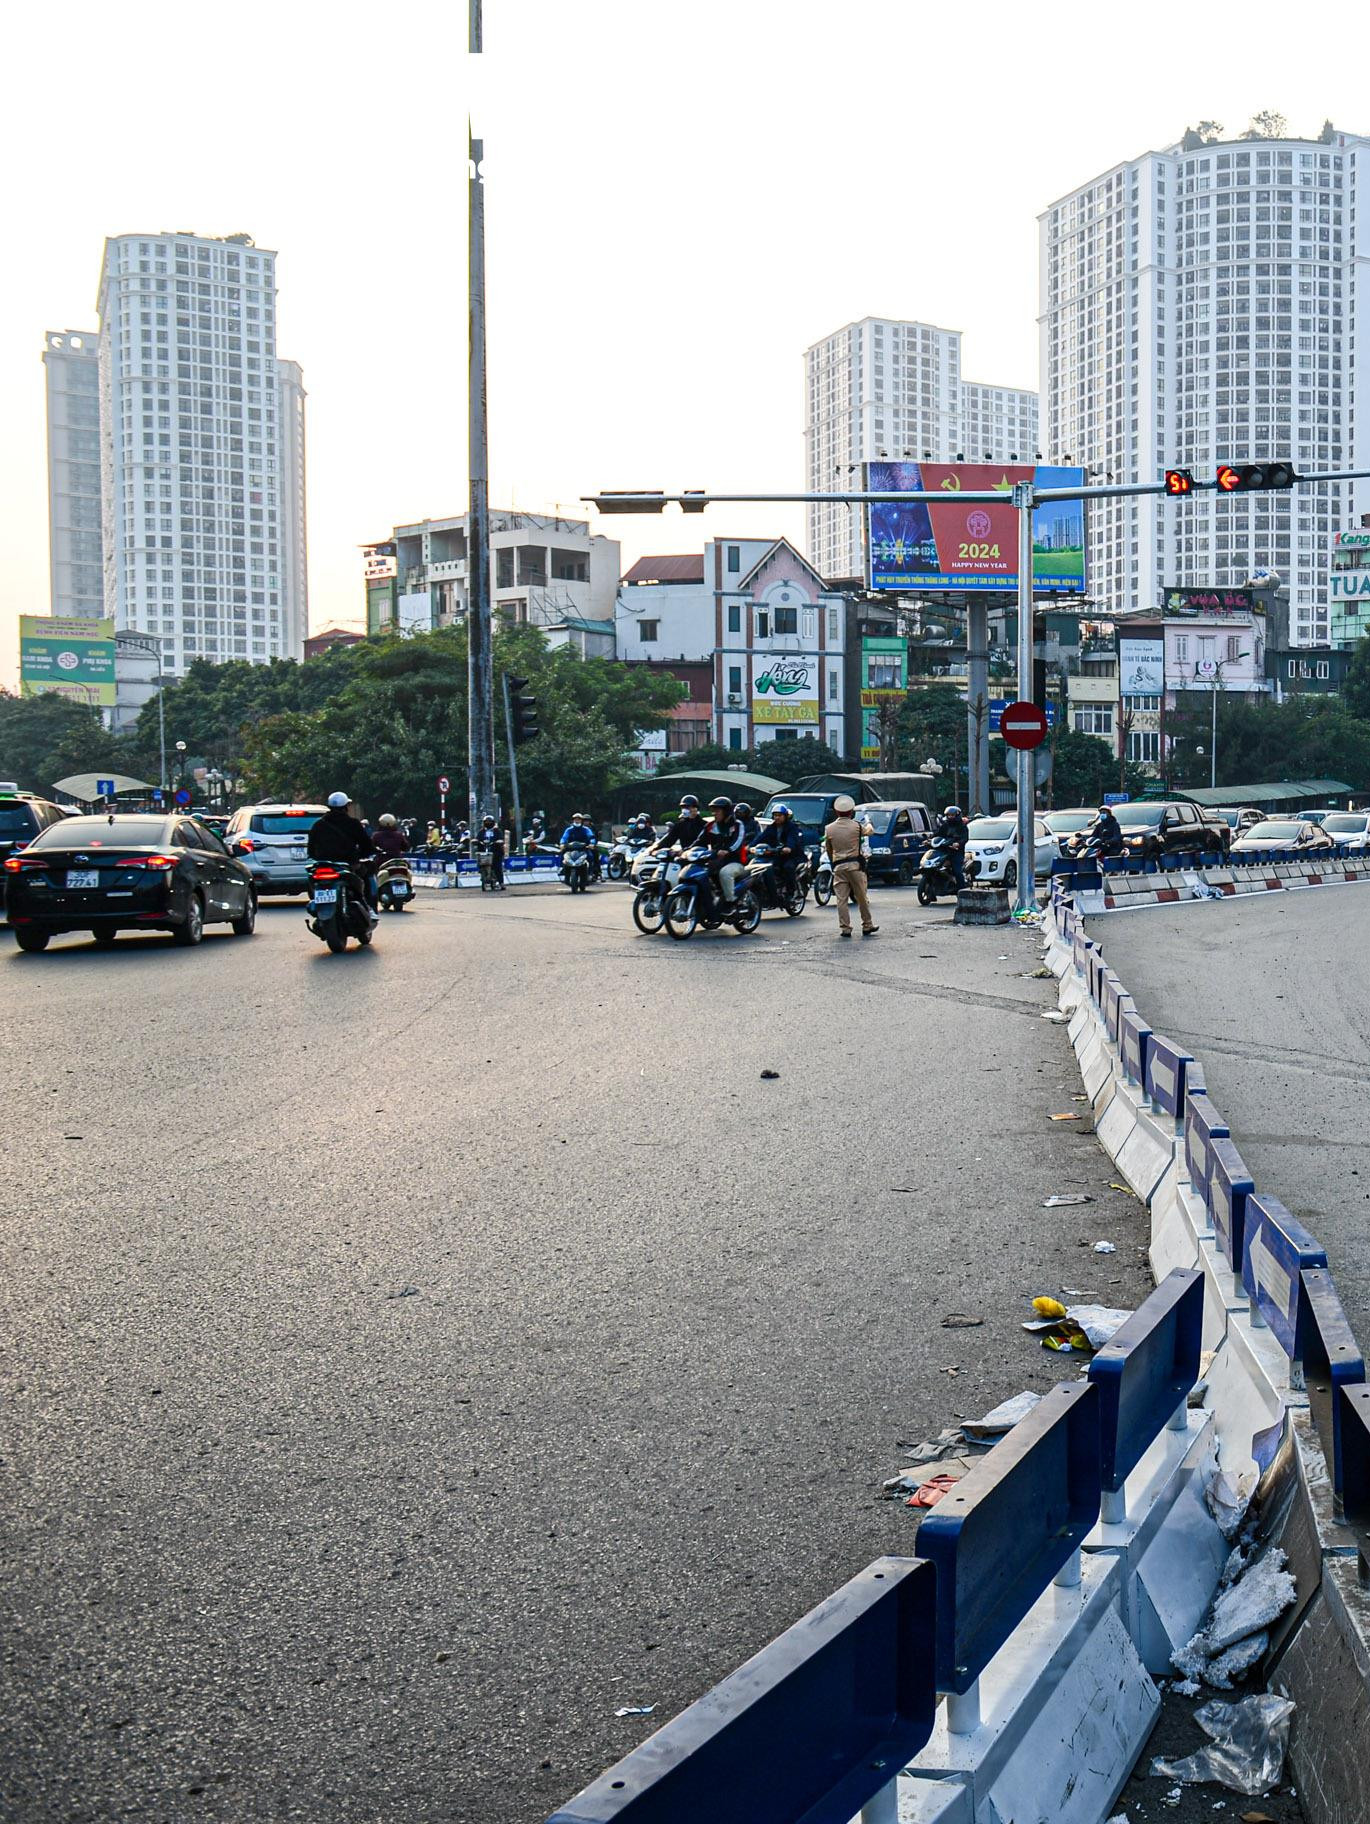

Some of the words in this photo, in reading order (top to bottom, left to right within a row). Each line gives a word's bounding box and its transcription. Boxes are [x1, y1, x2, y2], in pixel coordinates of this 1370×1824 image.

[1171, 478, 1187, 491] 51
[958, 543, 1001, 559] 2024
[757, 707, 771, 718] XE
[775, 706, 795, 718] TAY
[799, 706, 815, 718] GA
